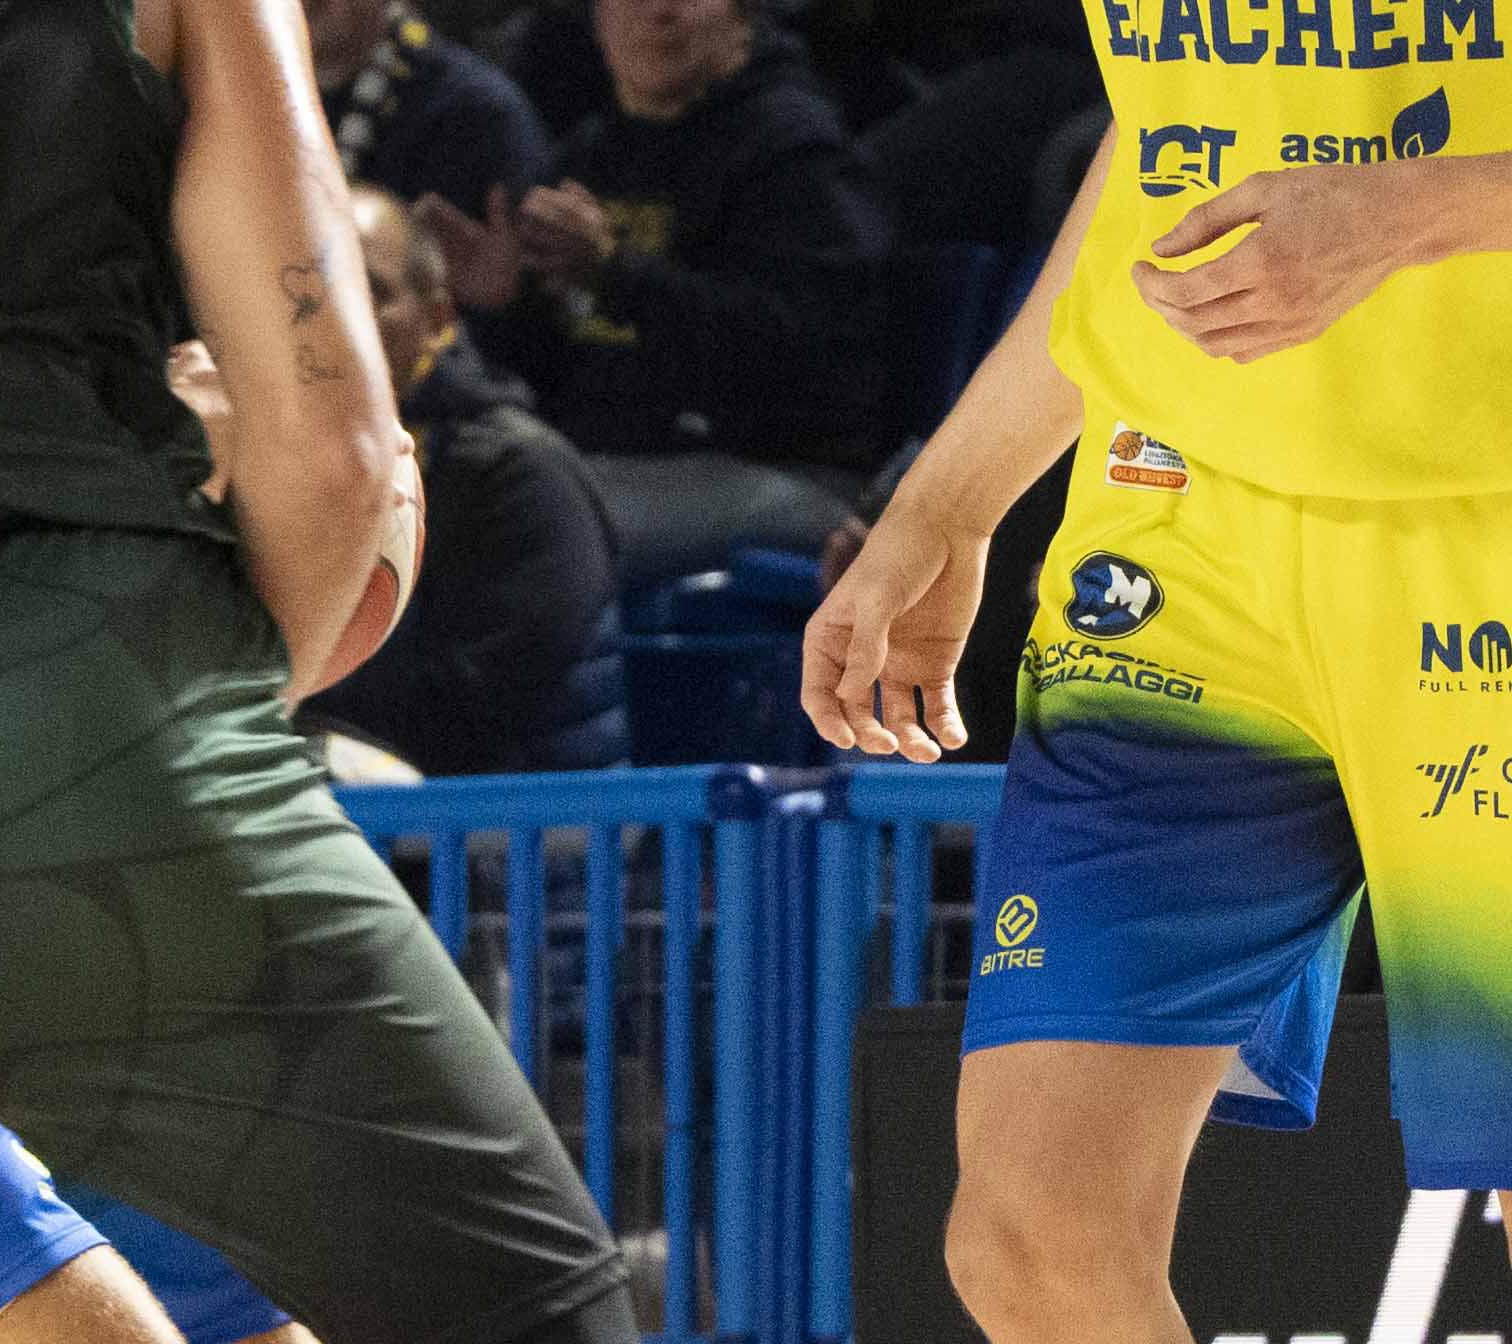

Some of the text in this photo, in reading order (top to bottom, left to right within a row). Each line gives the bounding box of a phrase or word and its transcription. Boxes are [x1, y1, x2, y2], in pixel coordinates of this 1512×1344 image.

[1280, 132, 1388, 164] asm
[1419, 679, 1468, 693] FULL
[980, 948, 1046, 976] BITRE
